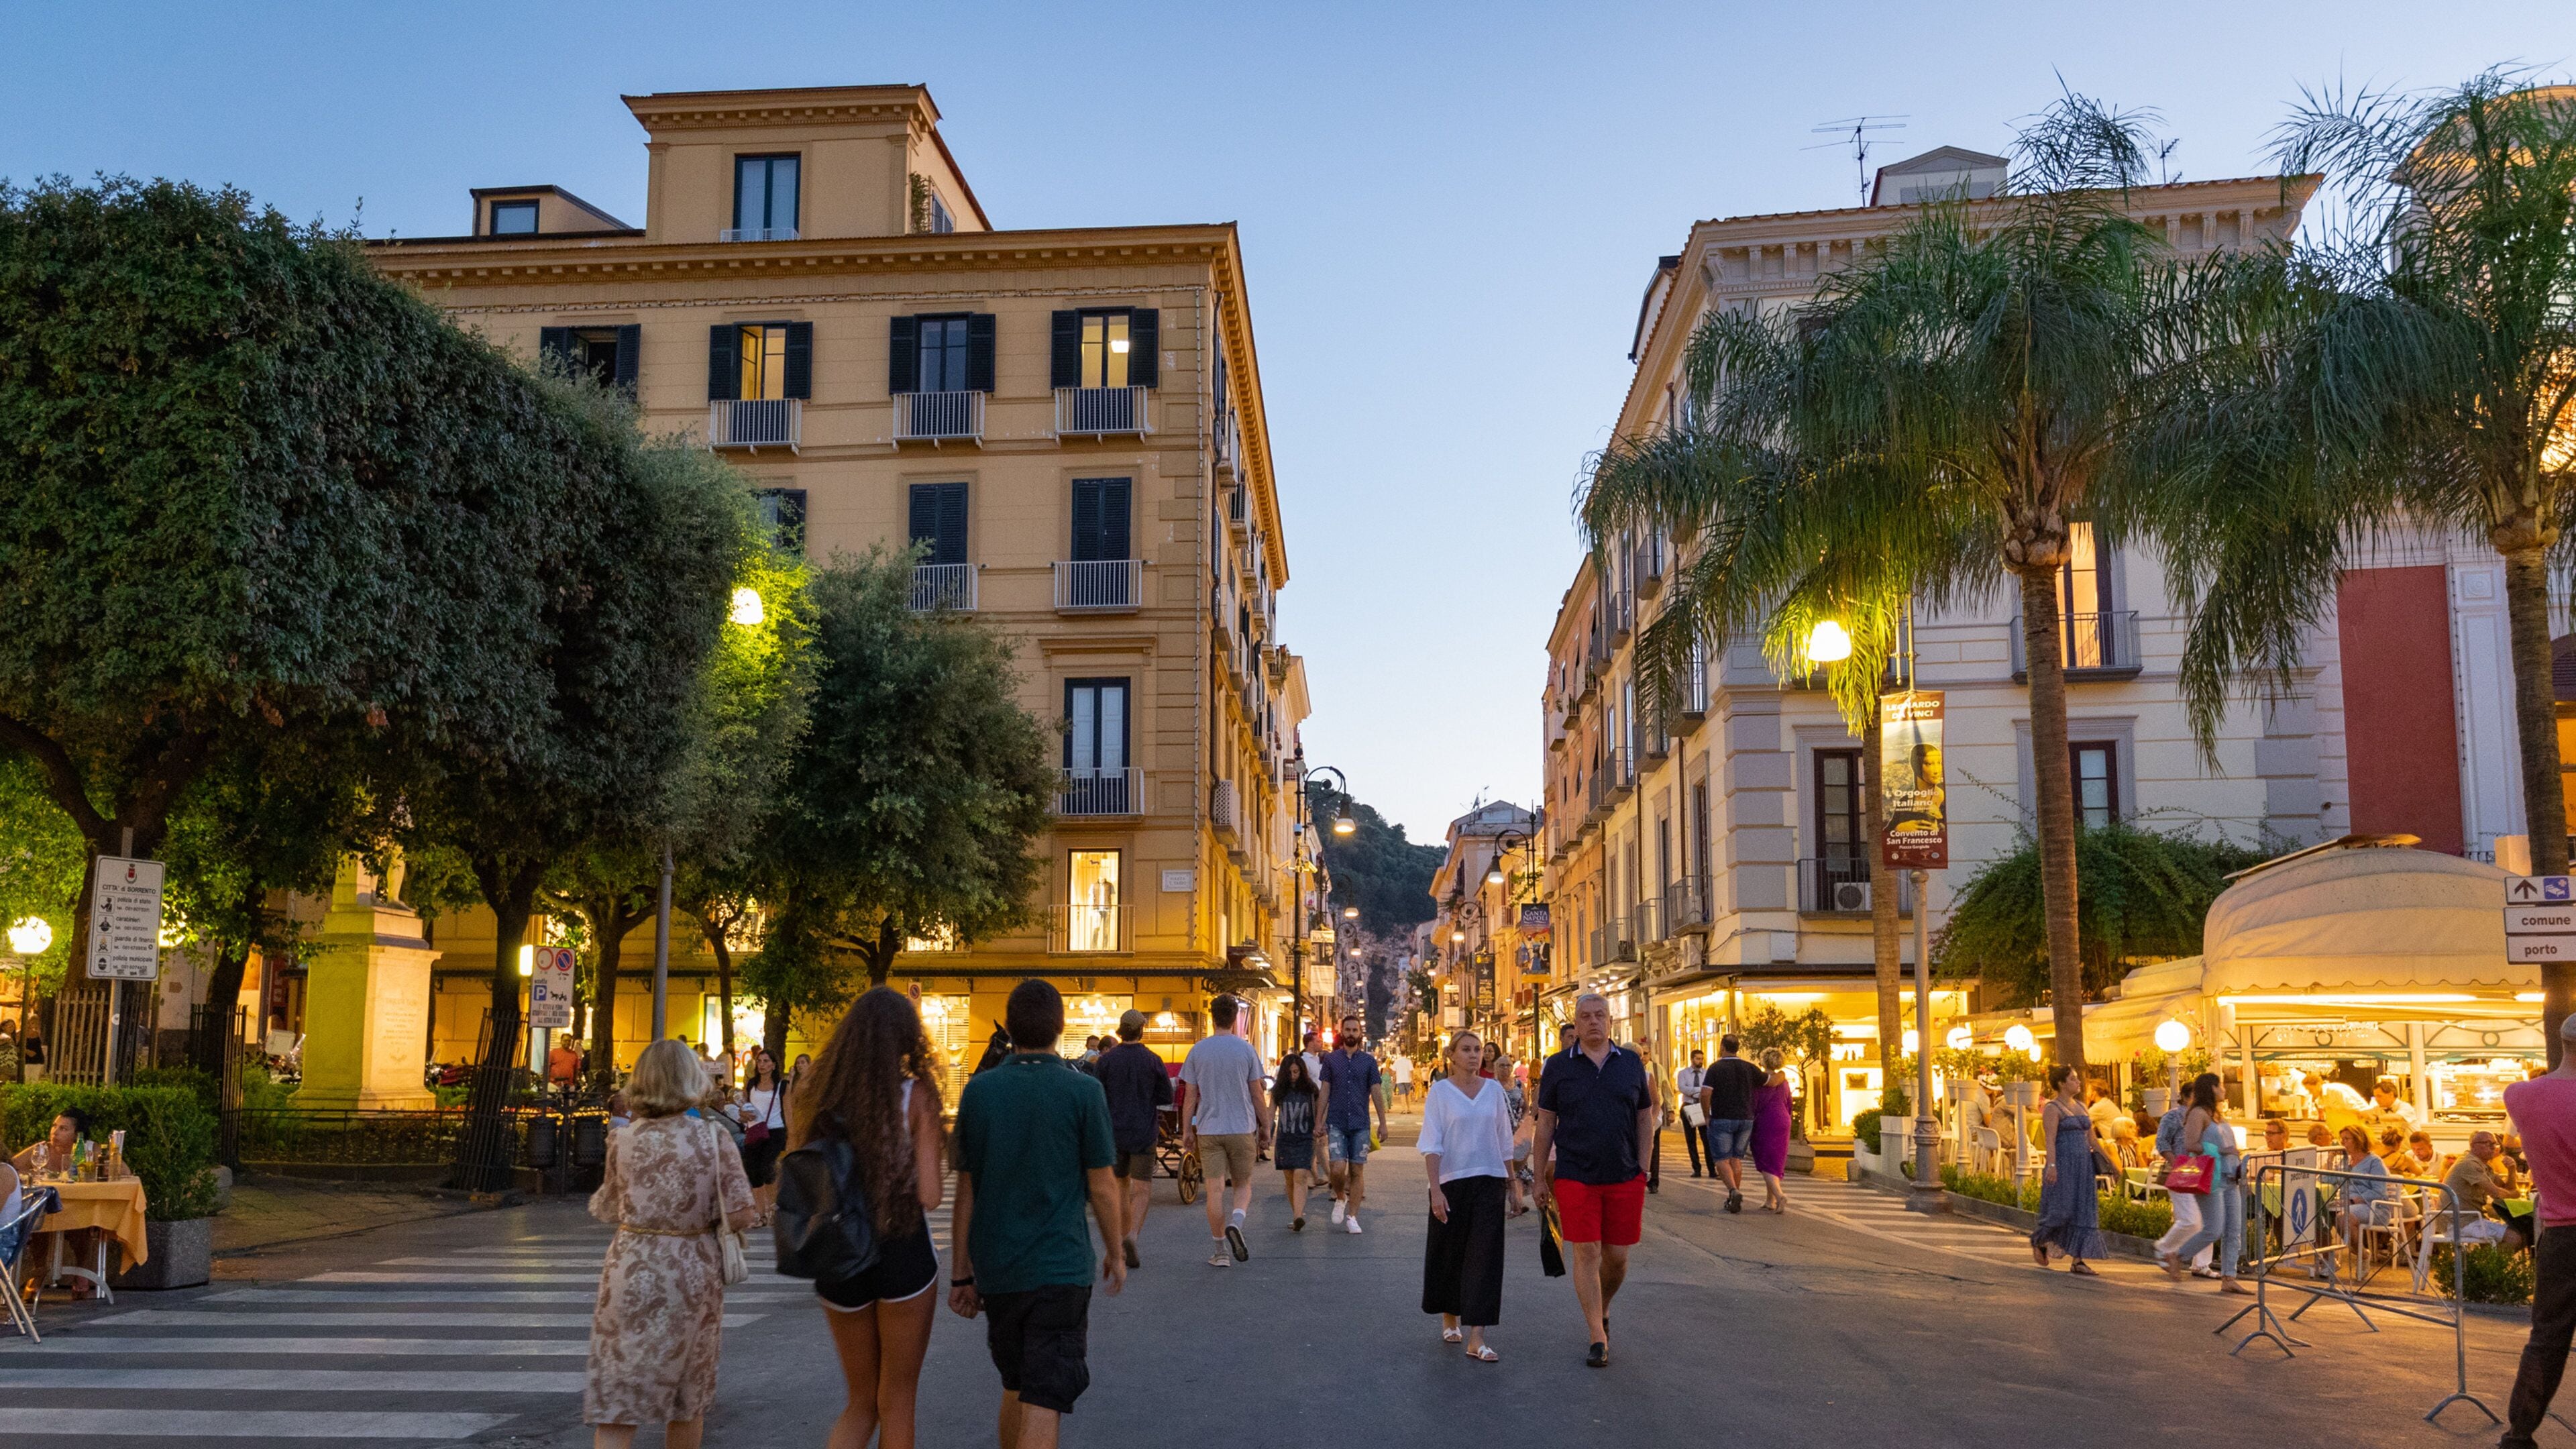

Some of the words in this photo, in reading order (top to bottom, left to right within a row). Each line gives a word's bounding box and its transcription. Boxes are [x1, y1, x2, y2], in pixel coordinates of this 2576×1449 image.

[1886, 700, 1940, 711] LEONARDO
[1907, 710, 1933, 718] VINCI
[1892, 799, 1933, 807] Italiano
[127, 886, 156, 894] SORRENTO
[2522, 916, 2571, 926] comune
[2524, 944, 2558, 957] porto
[1280, 1102, 1309, 1134] NYC
